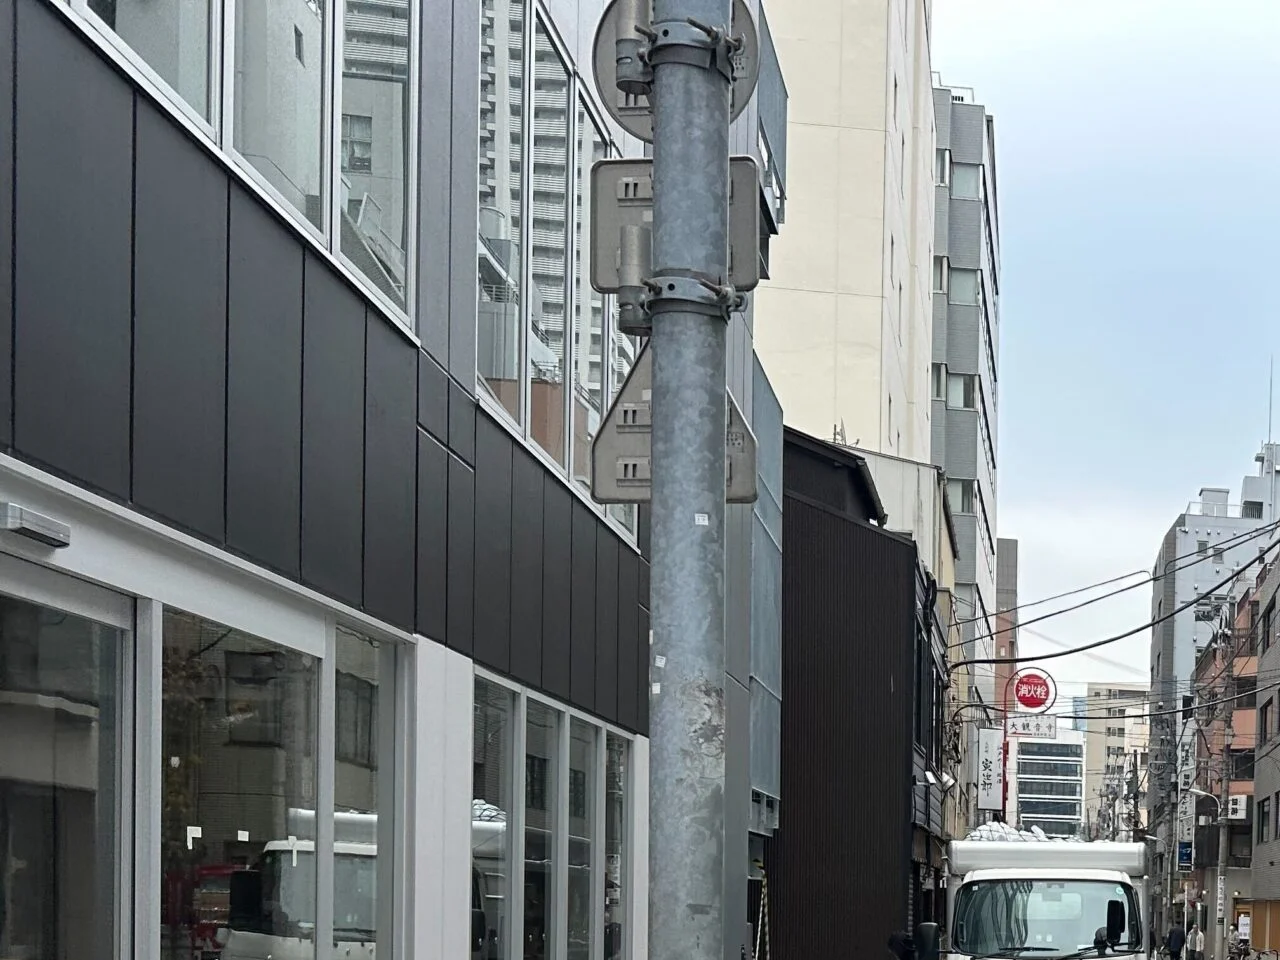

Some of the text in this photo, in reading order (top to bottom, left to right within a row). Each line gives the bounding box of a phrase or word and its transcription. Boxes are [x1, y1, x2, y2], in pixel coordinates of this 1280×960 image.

[1018, 683, 1047, 699] 消火栓
[1010, 721, 1053, 733] 大観音寺
